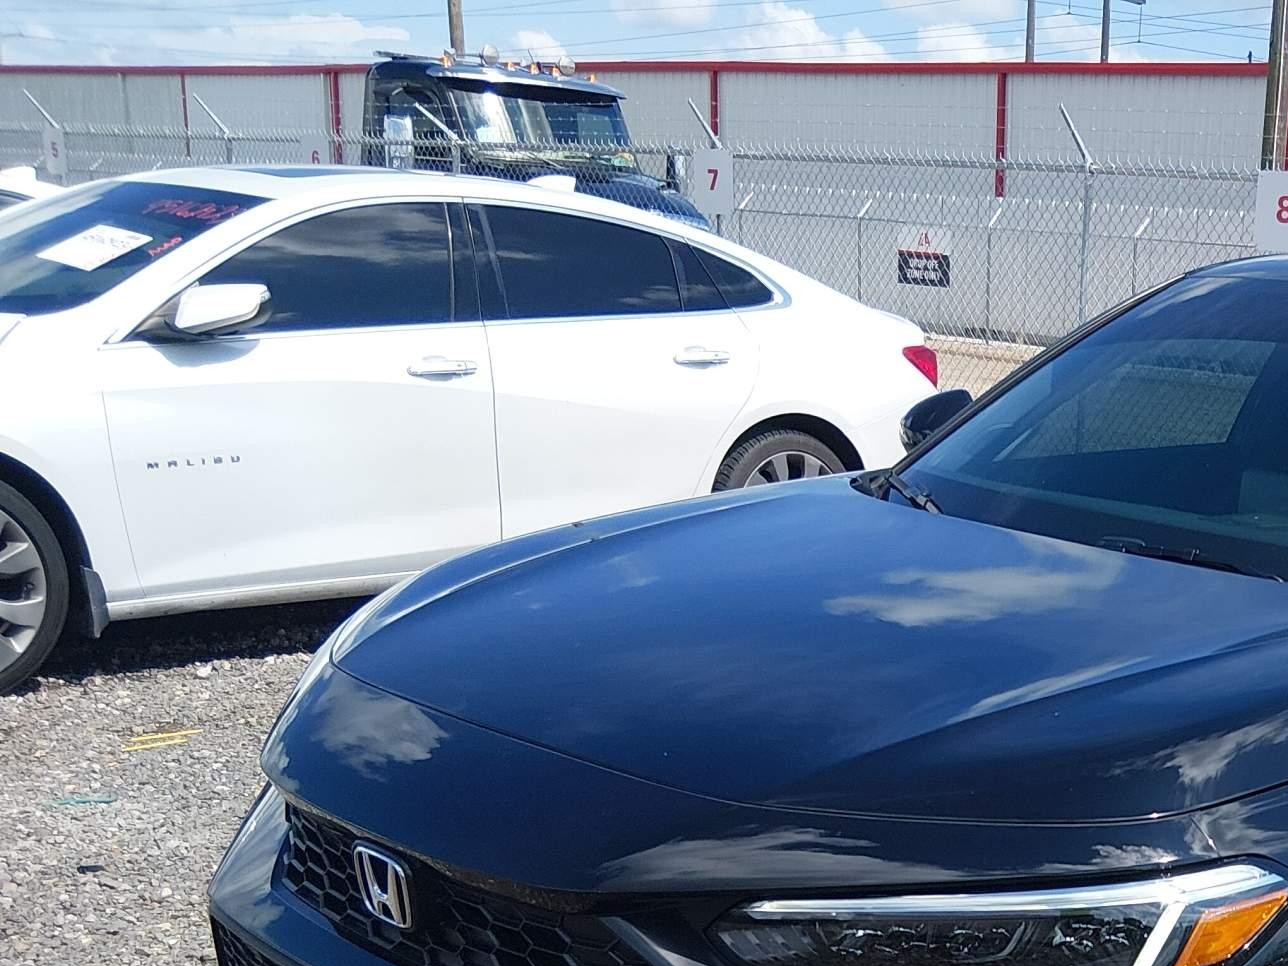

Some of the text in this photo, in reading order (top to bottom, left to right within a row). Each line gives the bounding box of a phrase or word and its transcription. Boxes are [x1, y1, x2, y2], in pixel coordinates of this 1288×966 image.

[51, 141, 59, 159] 5
[311, 150, 320, 165] 6
[707, 168, 719, 191] 7
[146, 455, 241, 469] MALIBU
